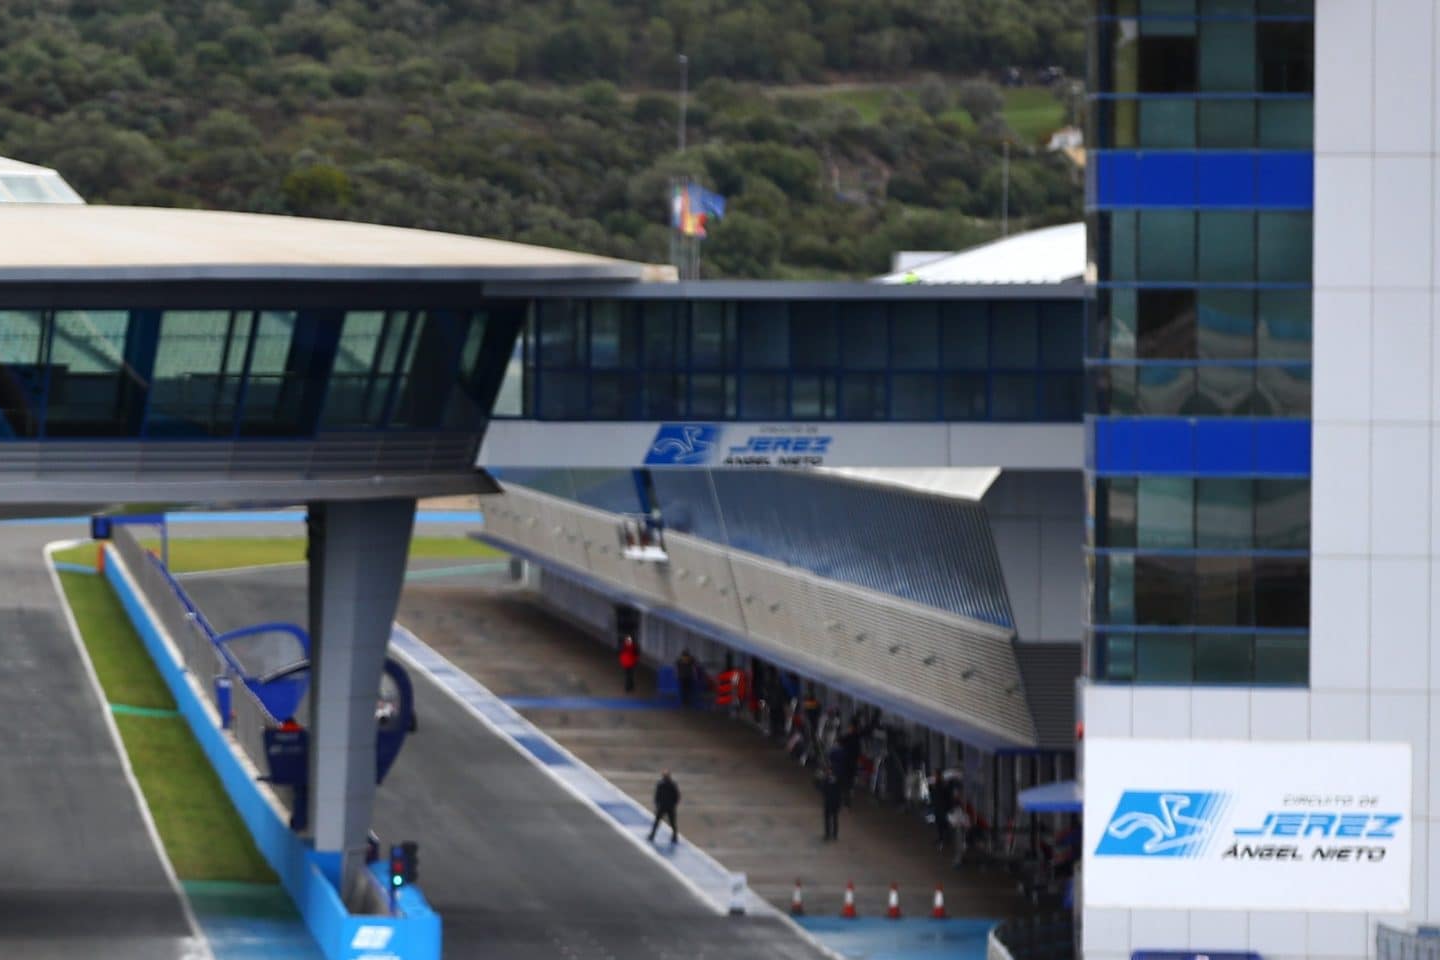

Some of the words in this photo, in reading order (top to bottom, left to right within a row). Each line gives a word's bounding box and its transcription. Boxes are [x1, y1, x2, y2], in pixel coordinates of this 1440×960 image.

[729, 436, 832, 453] JEREZ
[1282, 794, 1354, 806] CIRCUITO
[1233, 811, 1402, 838] JEREZ
[1222, 841, 1303, 860] ÁNGEL
[1310, 847, 1386, 861] NIETO
